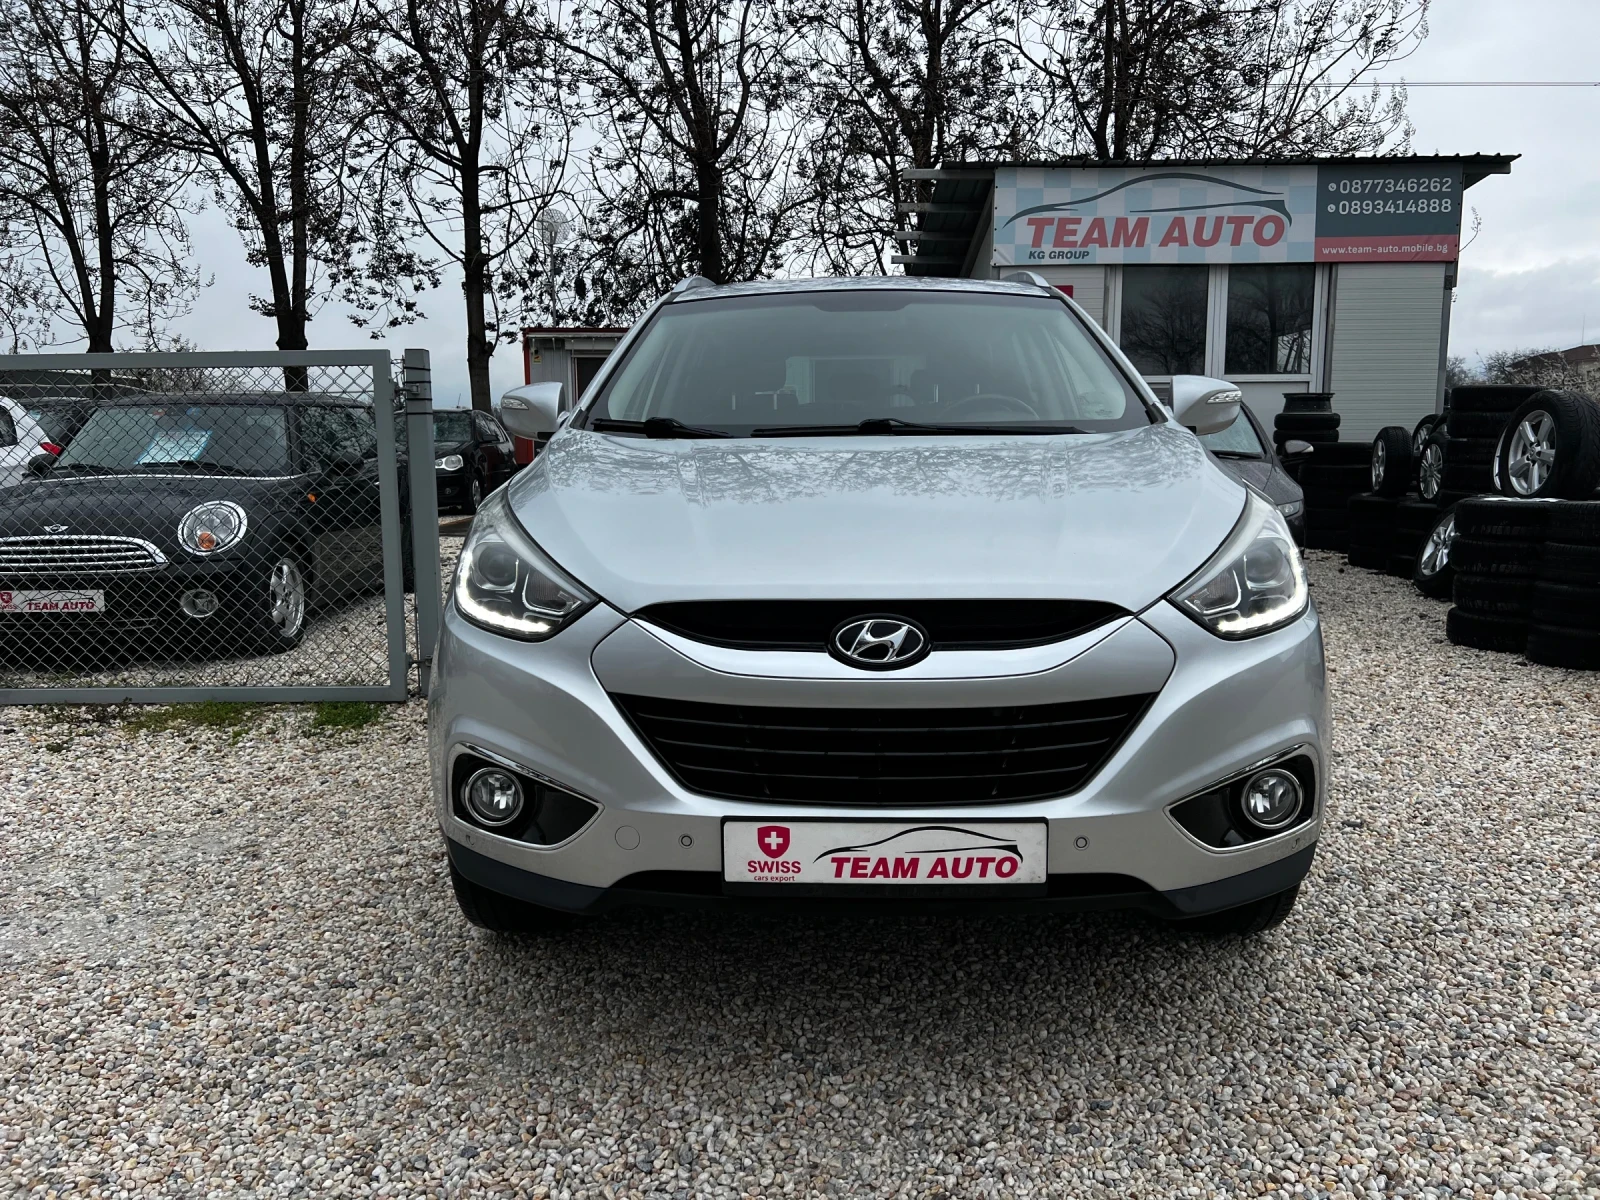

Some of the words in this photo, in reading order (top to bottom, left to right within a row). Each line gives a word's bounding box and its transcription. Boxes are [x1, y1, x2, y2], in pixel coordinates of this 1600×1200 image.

[1340, 178, 1452, 194] 0877346262
[1339, 198, 1452, 215] 0893414888
[1026, 216, 1150, 248] TEAM
[1158, 214, 1286, 248] AUTO
[1028, 250, 1046, 260] KG
[1048, 250, 1090, 260] GROUP
[1322, 243, 1448, 255] www.team-auto.mobile.bg
[27, 602, 59, 611] TEAM
[62, 601, 95, 610] AUTO
[747, 860, 802, 874] SWISS
[830, 856, 920, 879] TEAM
[926, 856, 1019, 879] AUTO
[770, 875, 796, 883] export
